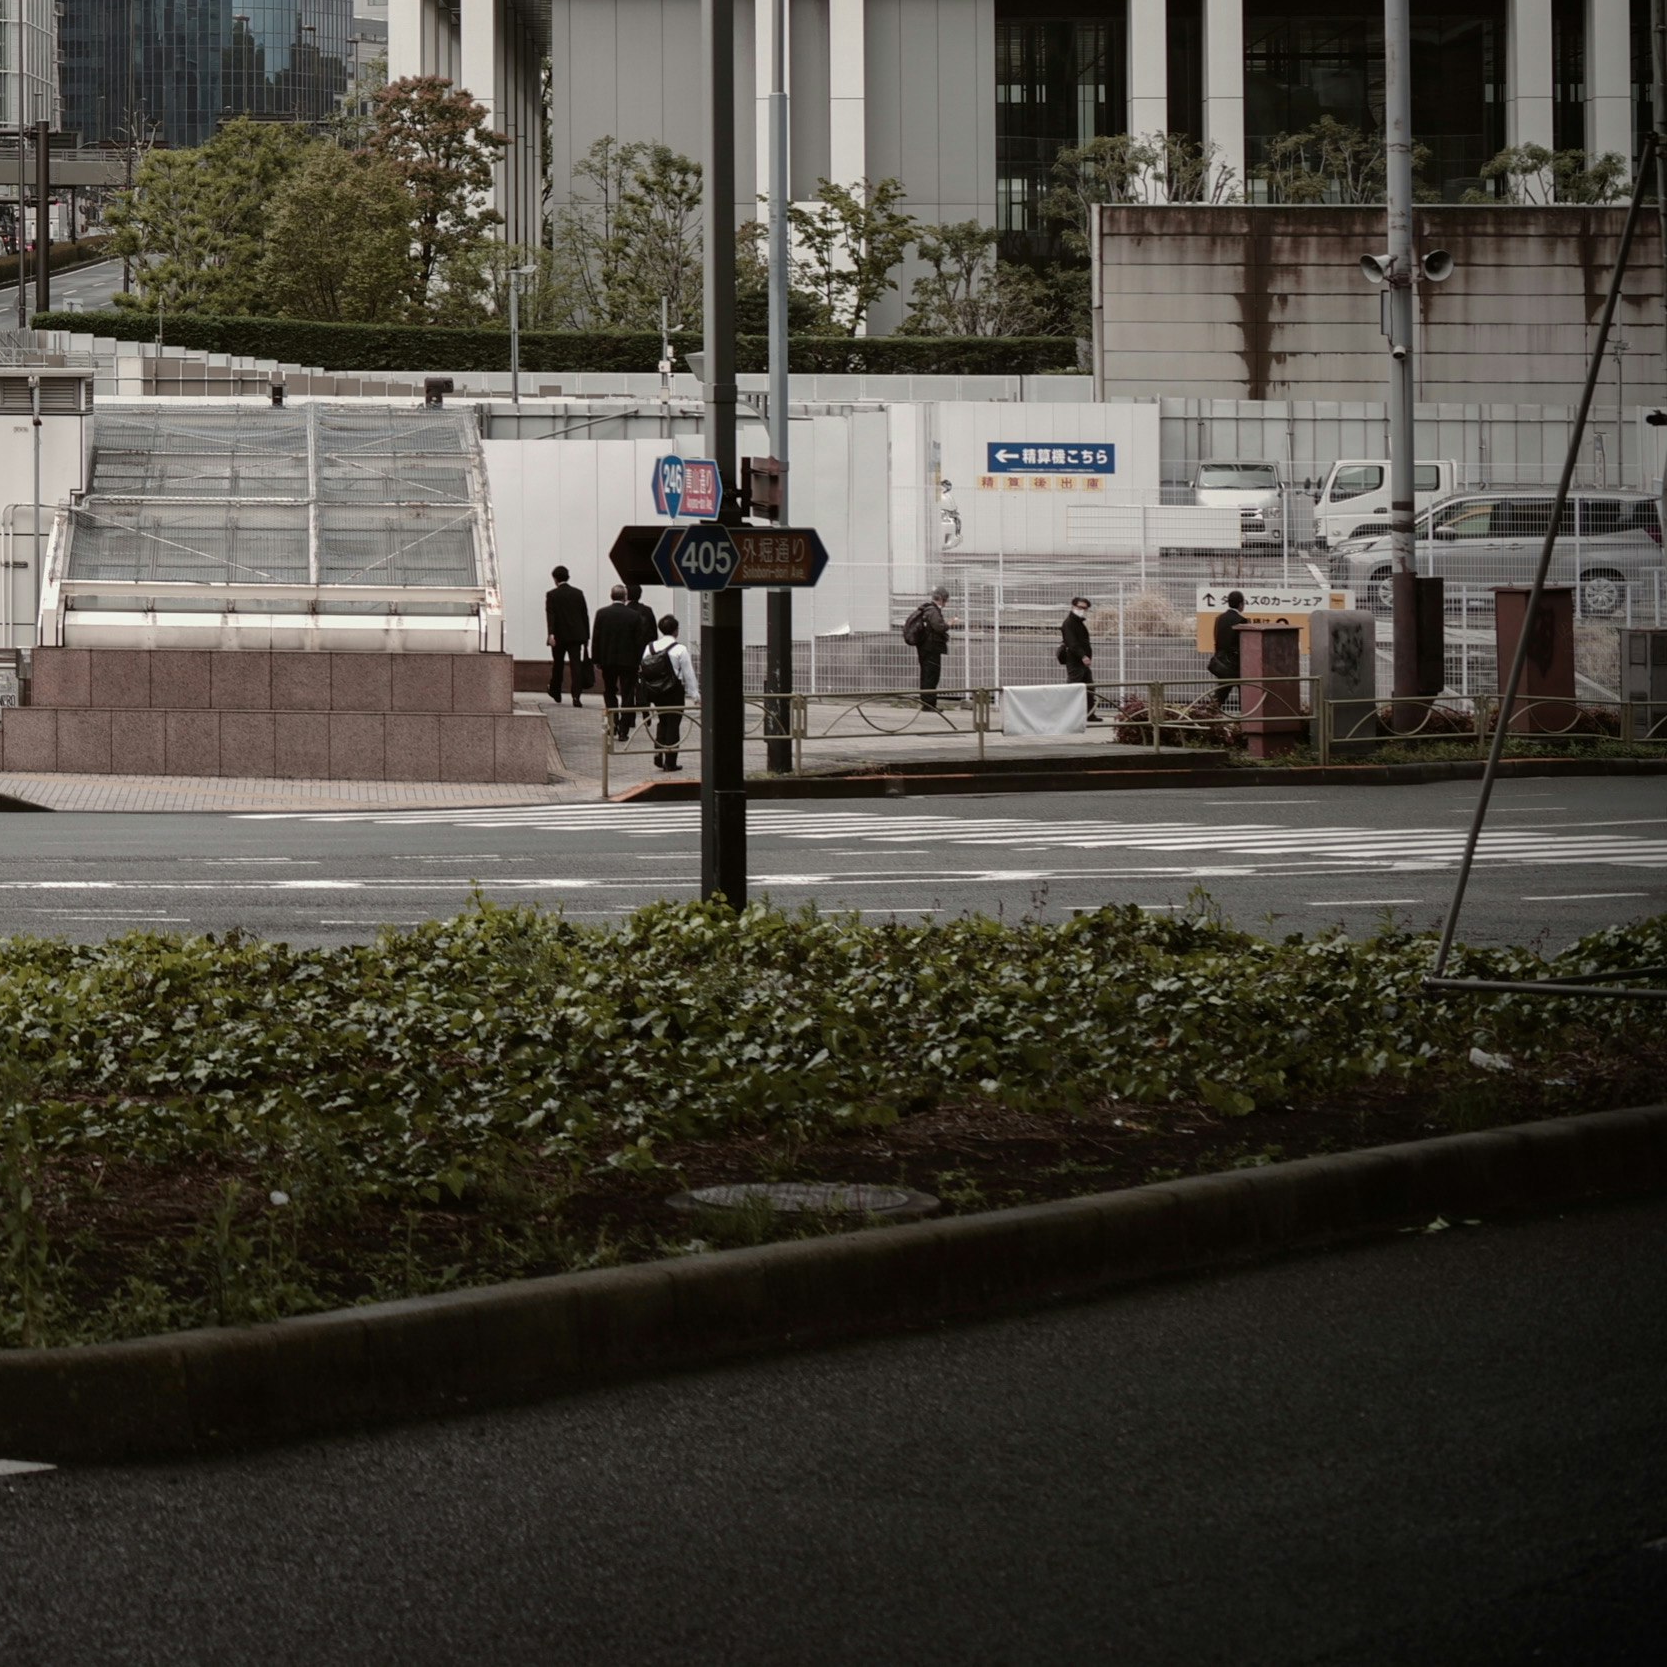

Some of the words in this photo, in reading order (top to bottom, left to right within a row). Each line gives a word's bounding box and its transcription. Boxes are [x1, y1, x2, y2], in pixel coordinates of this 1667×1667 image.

[1021, 448, 1108, 465] 精算機こちら
[663, 464, 683, 494] 246
[981, 476, 1099, 490] 精算後出庫
[681, 541, 732, 575] 405
[742, 537, 805, 564] 外堀通り
[1221, 594, 1323, 607] タムズのカーシェア
